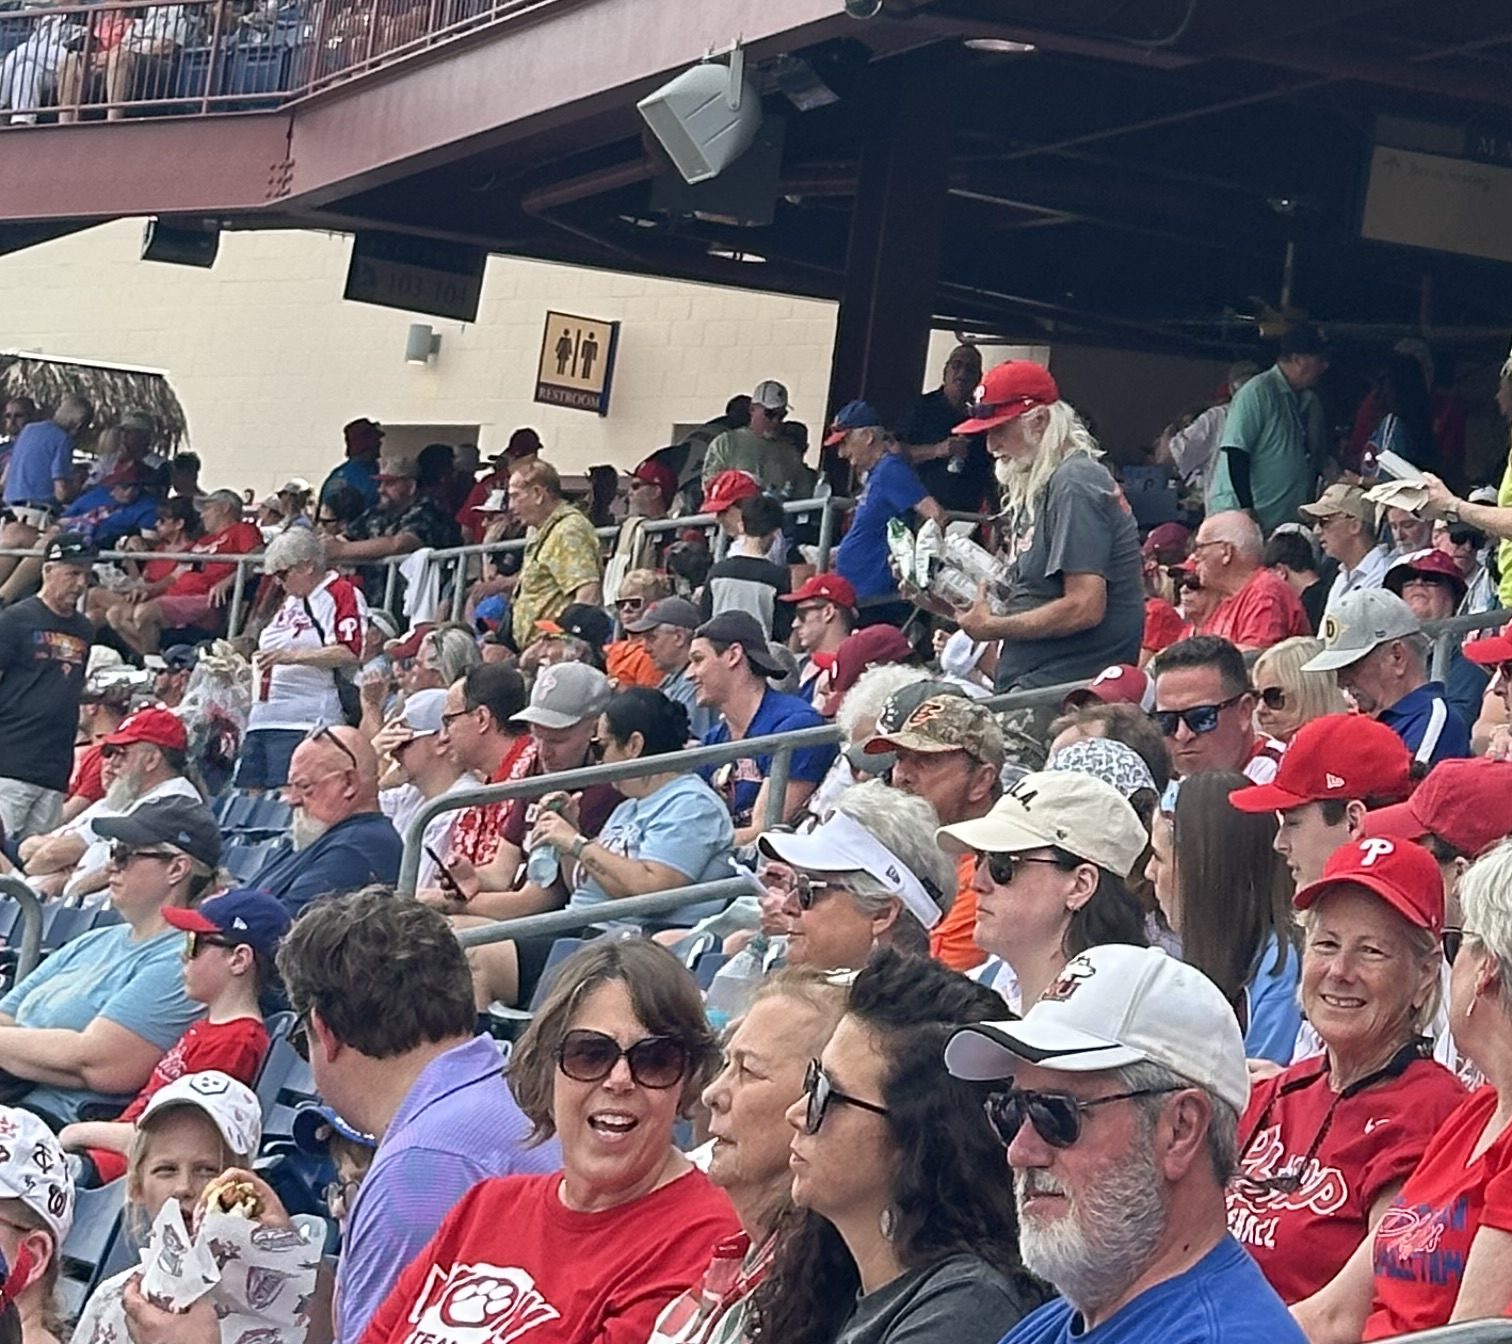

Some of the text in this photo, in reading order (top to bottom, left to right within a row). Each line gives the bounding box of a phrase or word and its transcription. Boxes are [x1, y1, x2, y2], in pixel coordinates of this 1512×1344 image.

[538, 387, 600, 408] RESTROOM
[339, 617, 357, 641] P
[1359, 837, 1395, 867] P
